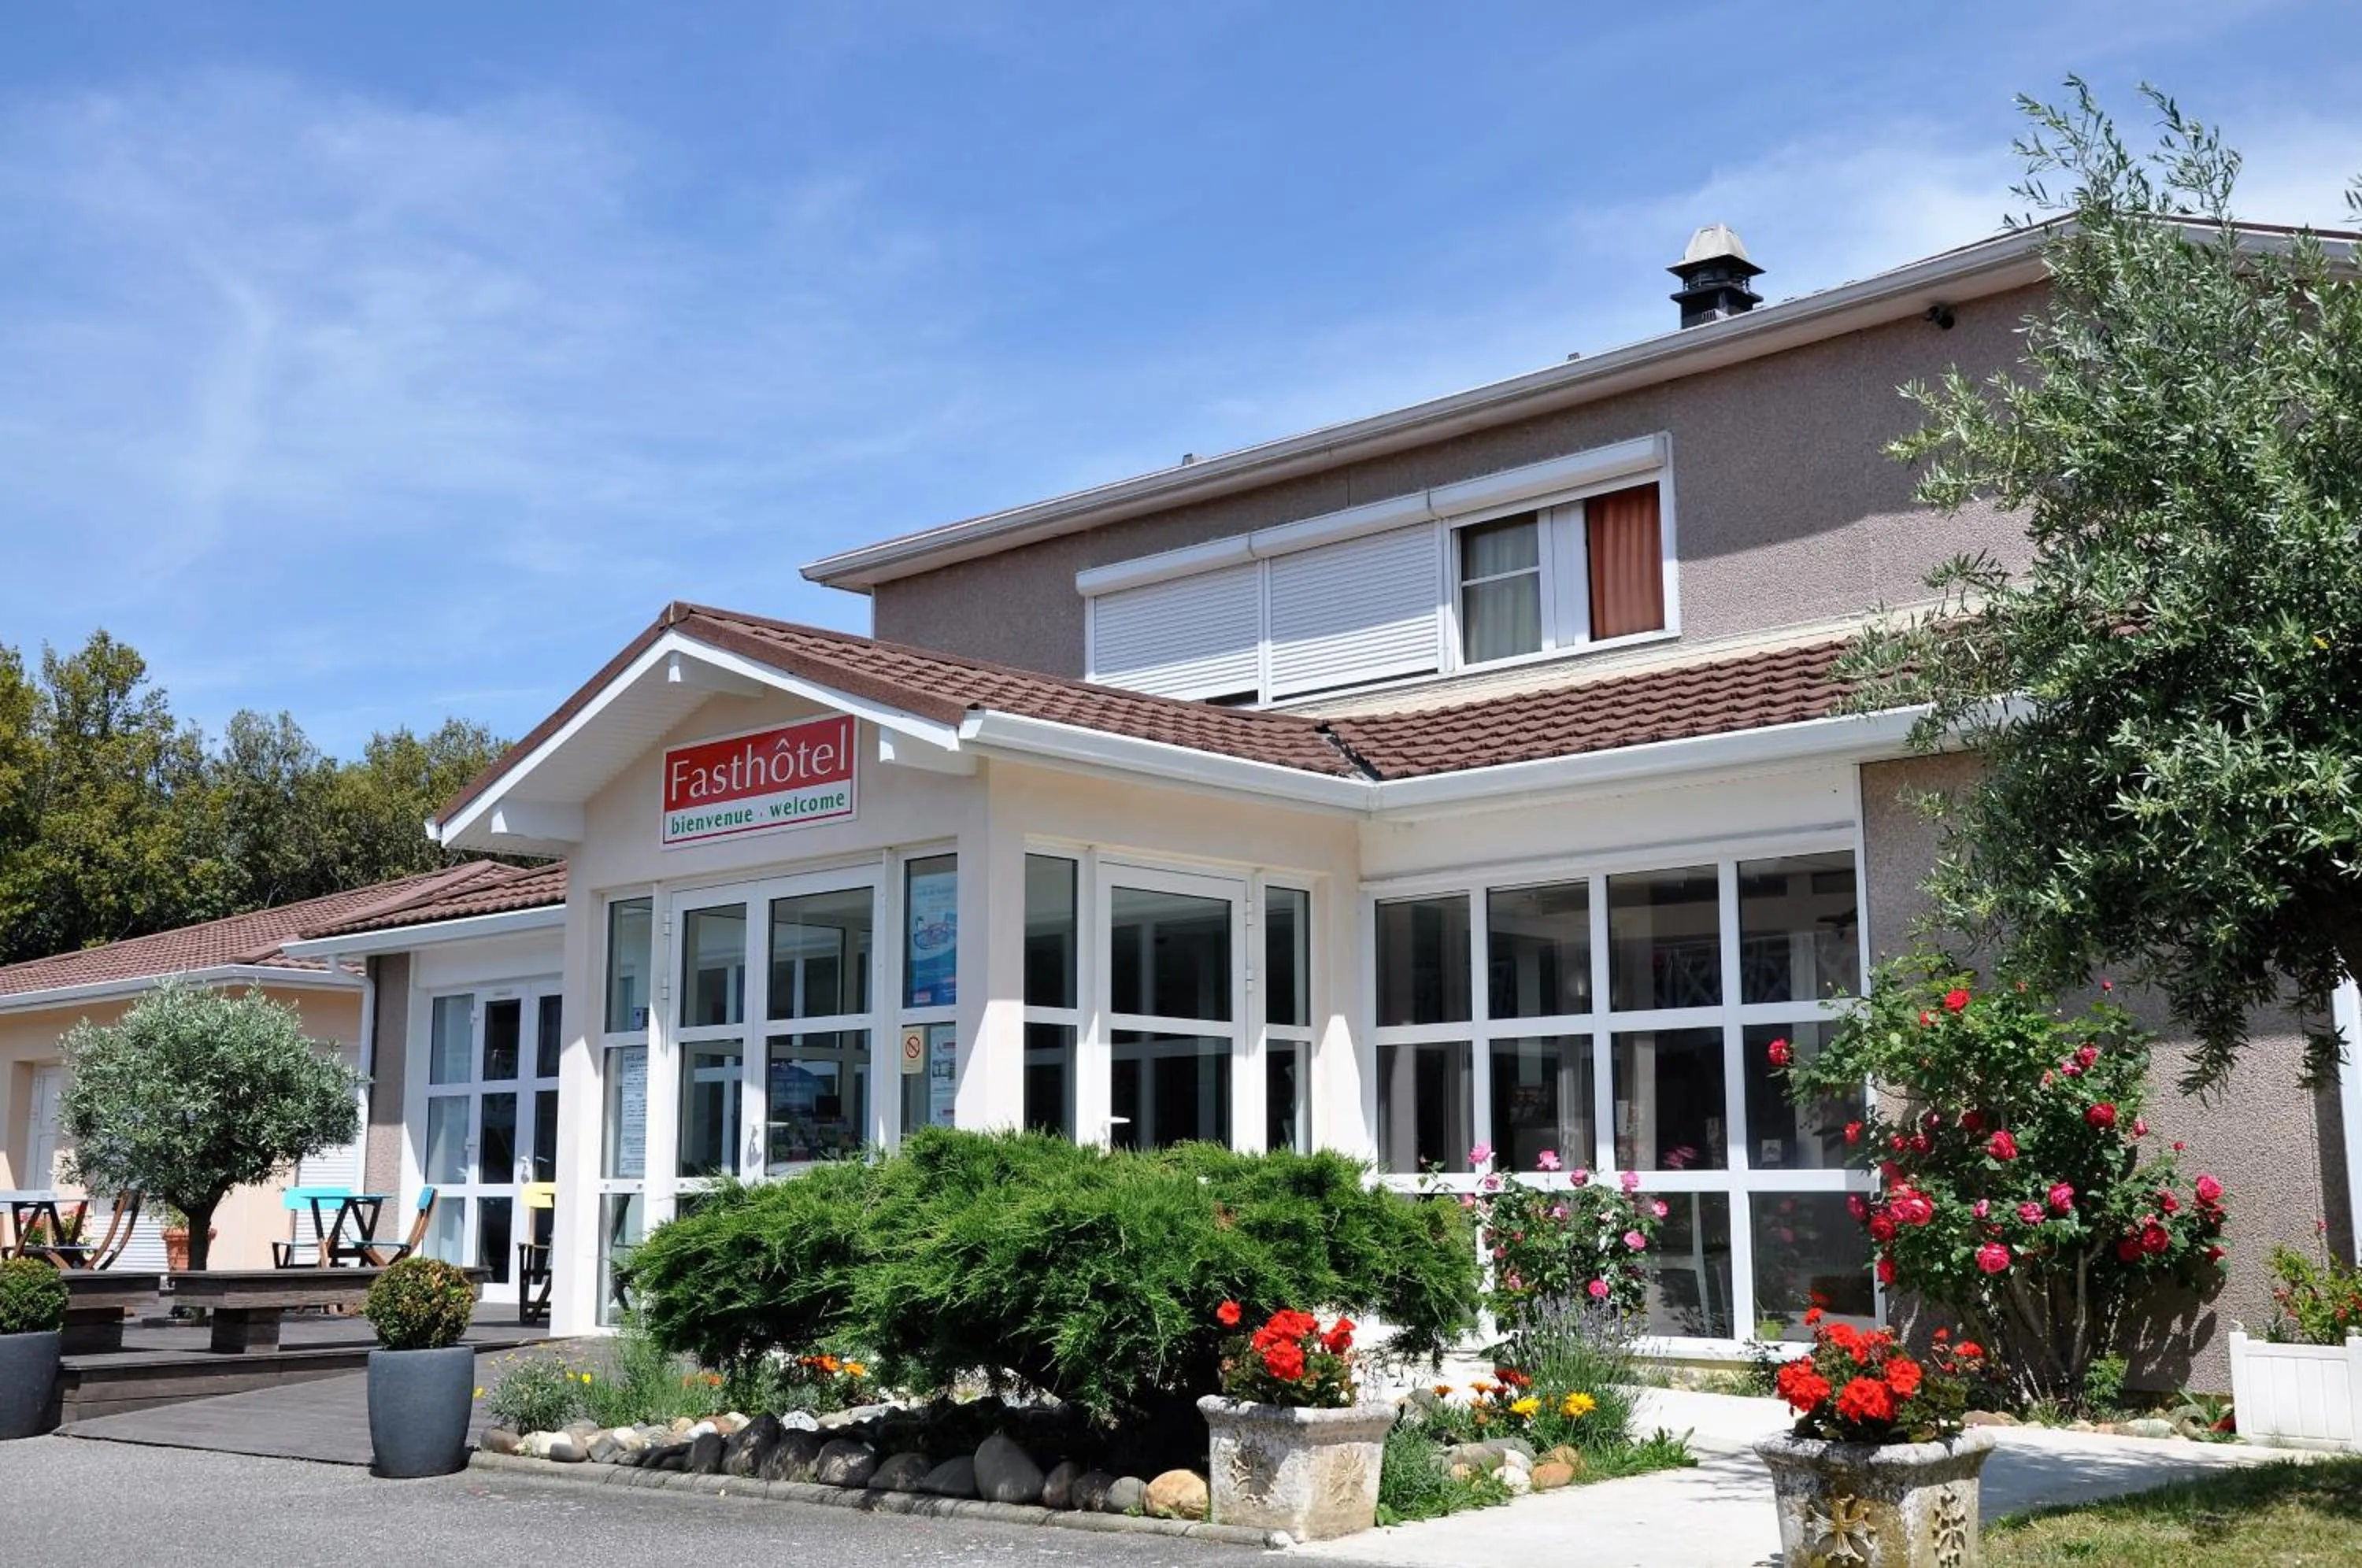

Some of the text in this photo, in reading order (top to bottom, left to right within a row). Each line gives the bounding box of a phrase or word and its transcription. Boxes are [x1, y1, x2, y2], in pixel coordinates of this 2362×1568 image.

[672, 723, 846, 801] Fasthôtel
[672, 808, 753, 834] bienvenue
[769, 792, 845, 817] welcome
